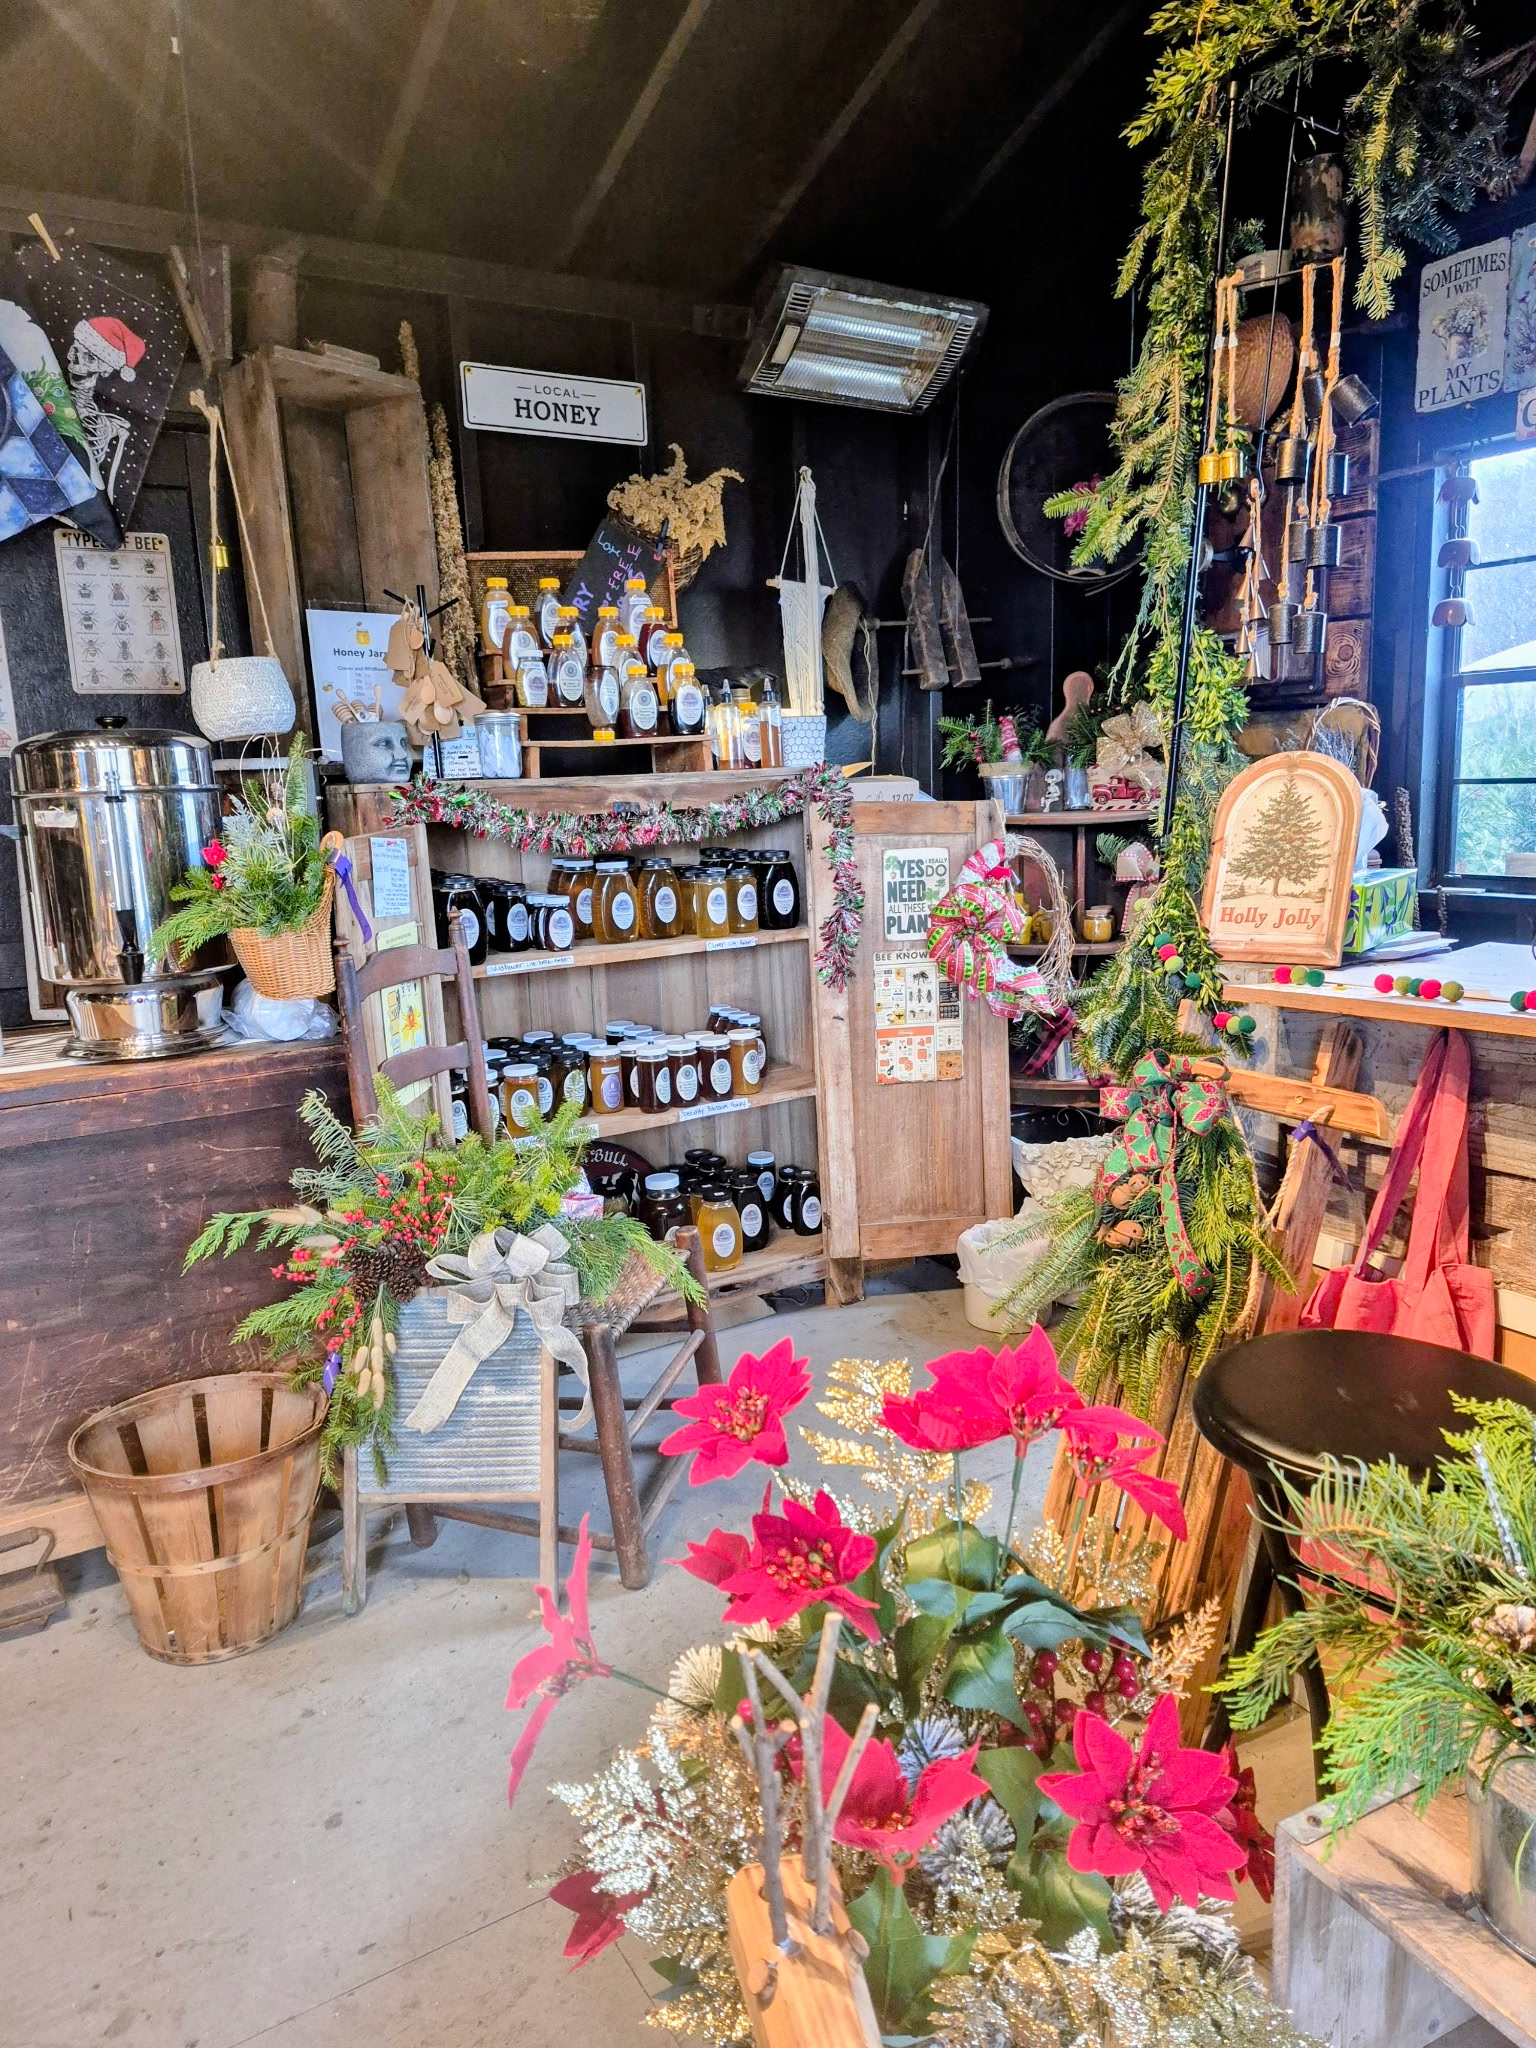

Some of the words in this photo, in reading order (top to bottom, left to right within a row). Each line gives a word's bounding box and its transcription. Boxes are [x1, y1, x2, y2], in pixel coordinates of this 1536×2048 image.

[1423, 252, 1506, 298] SOMETIMES
[1446, 286, 1451, 299] I
[1452, 276, 1482, 296] WET
[1445, 361, 1472, 382] MY
[534, 384, 580, 399] LOCAL
[1417, 369, 1500, 410] PLANTS
[513, 398, 601, 426] HONEY
[66, 532, 105, 548] TYPE
[571, 582, 595, 619] RY
[333, 648, 365, 659] Honey
[898, 859, 925, 879] YES
[925, 863, 947, 878] DO
[887, 879, 927, 903] NEED
[888, 904, 902, 914] ALL
[903, 903, 927, 913] THESE
[1220, 906, 1268, 929] Holly
[1273, 907, 1322, 931] Jolly
[886, 914, 931, 935] PLAN
[875, 953, 892, 961] BEE
[896, 951, 929, 960] KNOW
